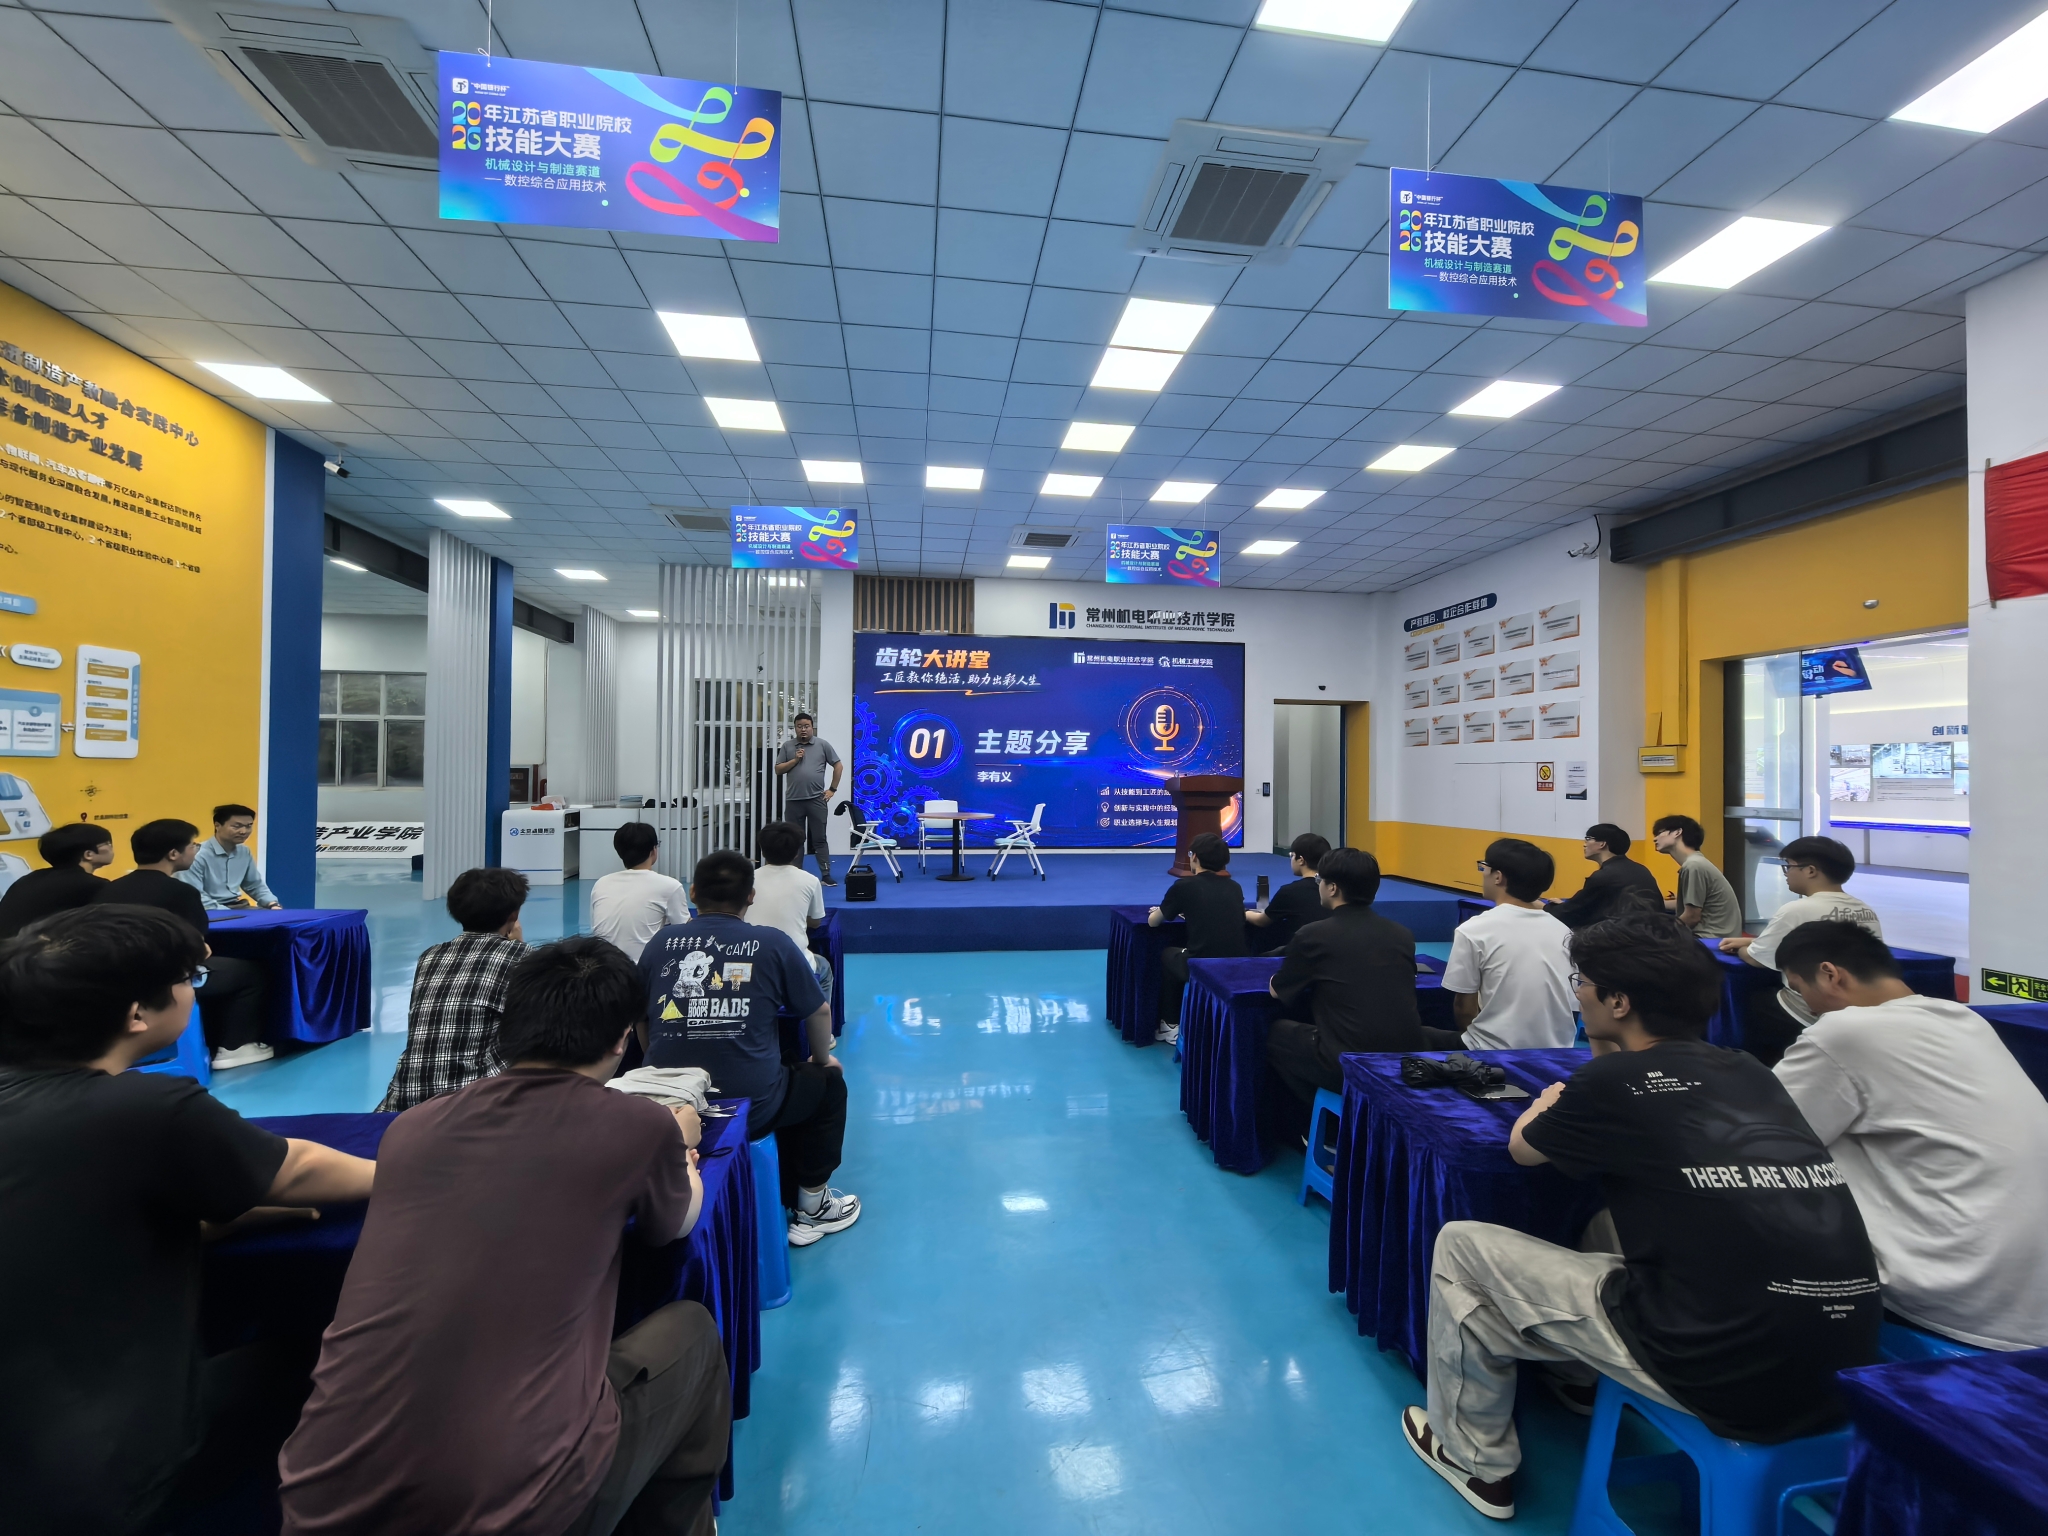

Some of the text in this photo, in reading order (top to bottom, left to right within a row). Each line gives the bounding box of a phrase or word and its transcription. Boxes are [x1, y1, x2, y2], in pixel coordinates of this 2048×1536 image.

[452, 100, 481, 126] 20
[484, 104, 632, 134] 年江苏省职业院校
[485, 125, 601, 161] 技能大赛
[485, 157, 601, 178] 机械设计与制造赛道
[1423, 212, 1535, 237] 年江苏省职业院校
[1424, 230, 1512, 260] 技能大赛
[1424, 257, 1512, 275] 机械设计与制造赛道
[748, 532, 791, 542] 技能大赛
[1121, 549, 1160, 560] 技能大赛
[1086, 607, 1235, 627] 常州机电职业技术学院
[875, 647, 990, 669] 齿轮大讲堂
[1087, 655, 1154, 664] 常州机电职业技术学院
[1172, 657, 1213, 666] 机械工程学院
[909, 728, 945, 759] 01
[975, 729, 1090, 755] 主题分享
[977, 771, 1012, 783] 李有义
[726, 940, 760, 957] CAMP
[688, 1006, 708, 1018] HOOPS
[1681, 1166, 1748, 1188] THERE
[1747, 1166, 1787, 1188] ARE
[1781, 1165, 1809, 1188] NO
